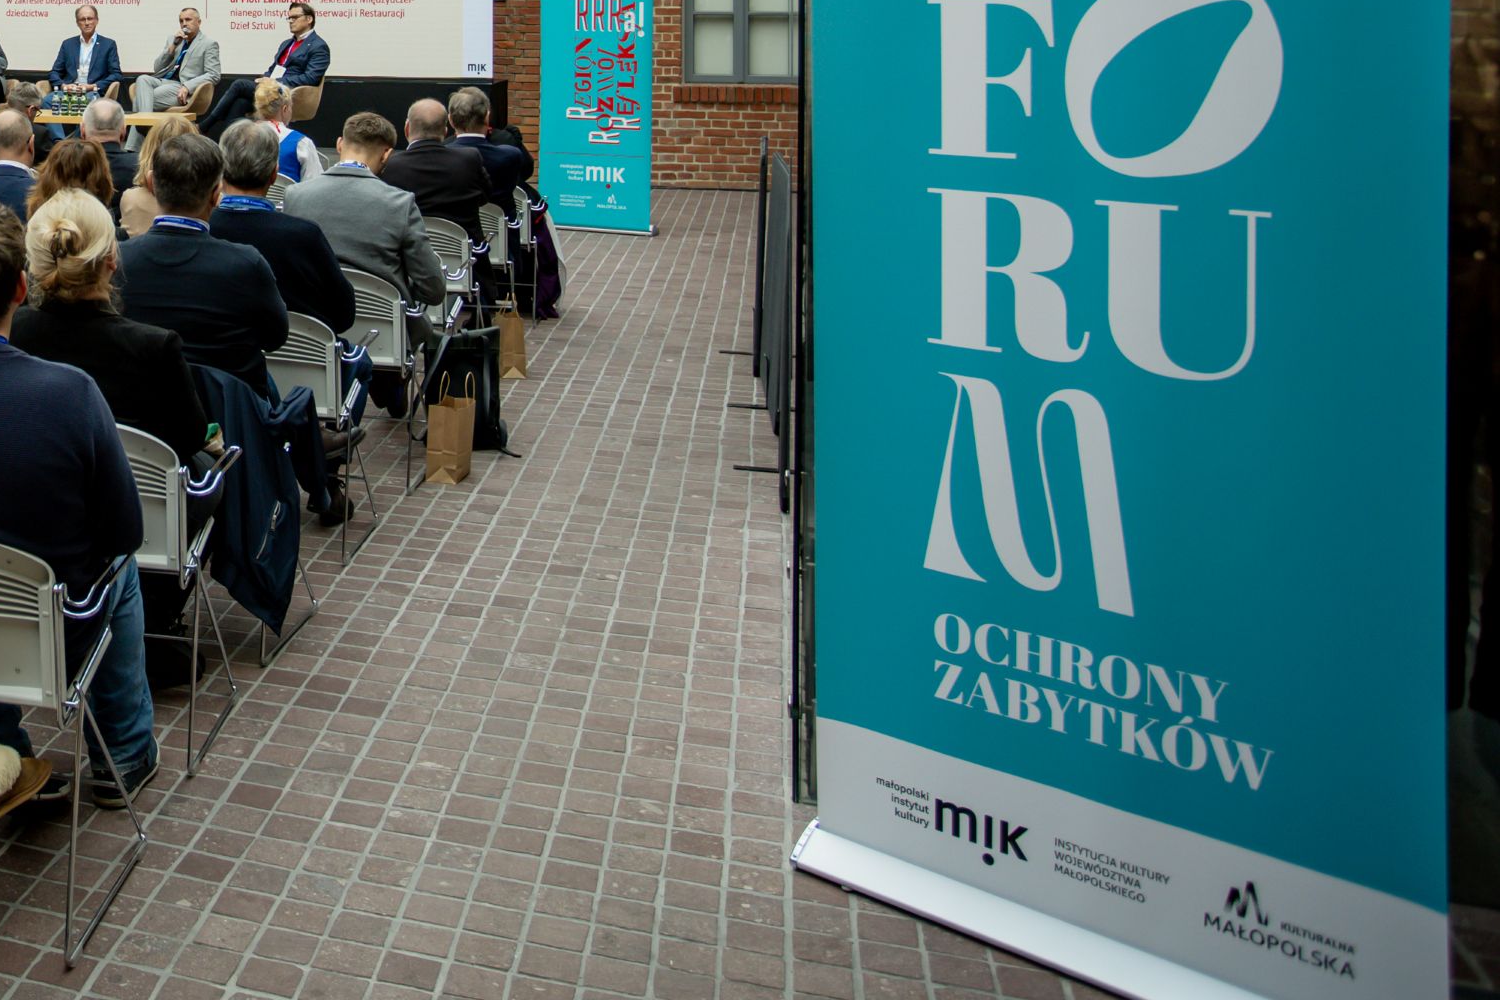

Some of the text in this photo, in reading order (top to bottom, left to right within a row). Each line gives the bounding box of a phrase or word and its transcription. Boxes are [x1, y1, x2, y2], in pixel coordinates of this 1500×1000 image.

[5, 9, 49, 18] dziedzictwa
[230, 9, 263, 18] nianego
[359, 7, 405, 18] Restauracji
[230, 20, 276, 30] Dzieł Sztuki
[932, 612, 1230, 724] OCHRONY
[932, 659, 1275, 792] ZABYTKÓW
[875, 776, 930, 801] małopolski
[890, 793, 930, 815] instytut
[894, 807, 930, 829] kultury
[1054, 837, 1171, 885] INSTYTUCJA KULTURY
[1054, 850, 1142, 890] WOJEWÓDZTWA
[1054, 863, 1146, 904] MAŁOPOLSKIEGO
[1203, 911, 1356, 980] MAŁOPOLSKA
[1280, 921, 1356, 954] KULTURALNA
